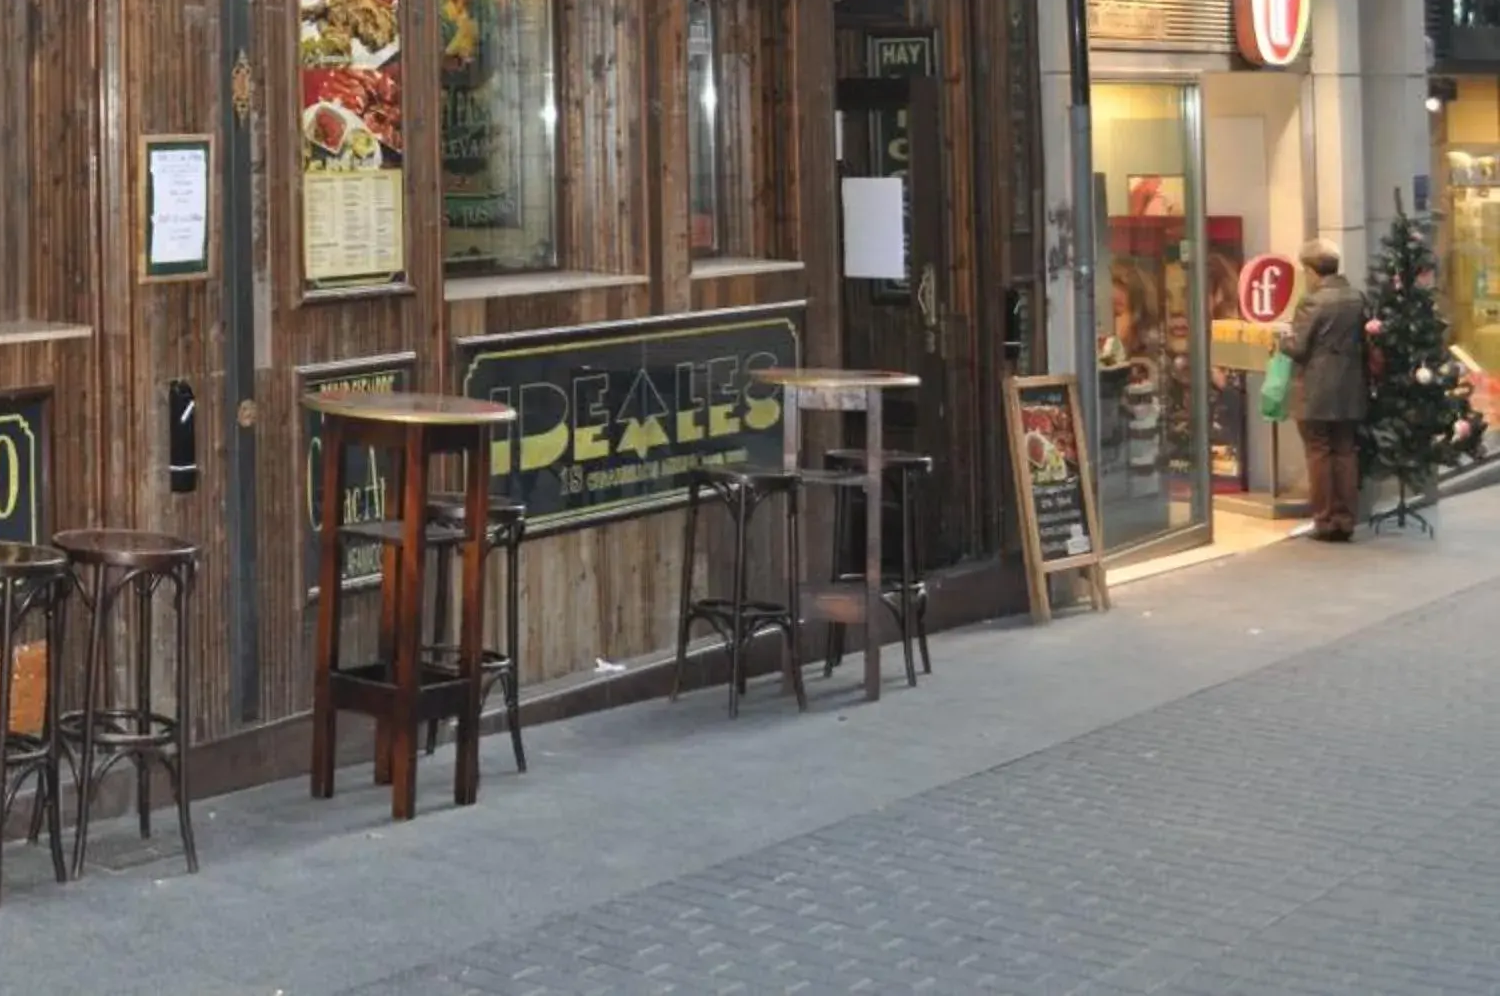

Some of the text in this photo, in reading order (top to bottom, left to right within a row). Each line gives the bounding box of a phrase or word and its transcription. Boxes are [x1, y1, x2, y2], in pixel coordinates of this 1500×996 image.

[882, 44, 921, 64] HAY
[1252, 266, 1281, 316] if
[490, 352, 780, 476] IDEALES
